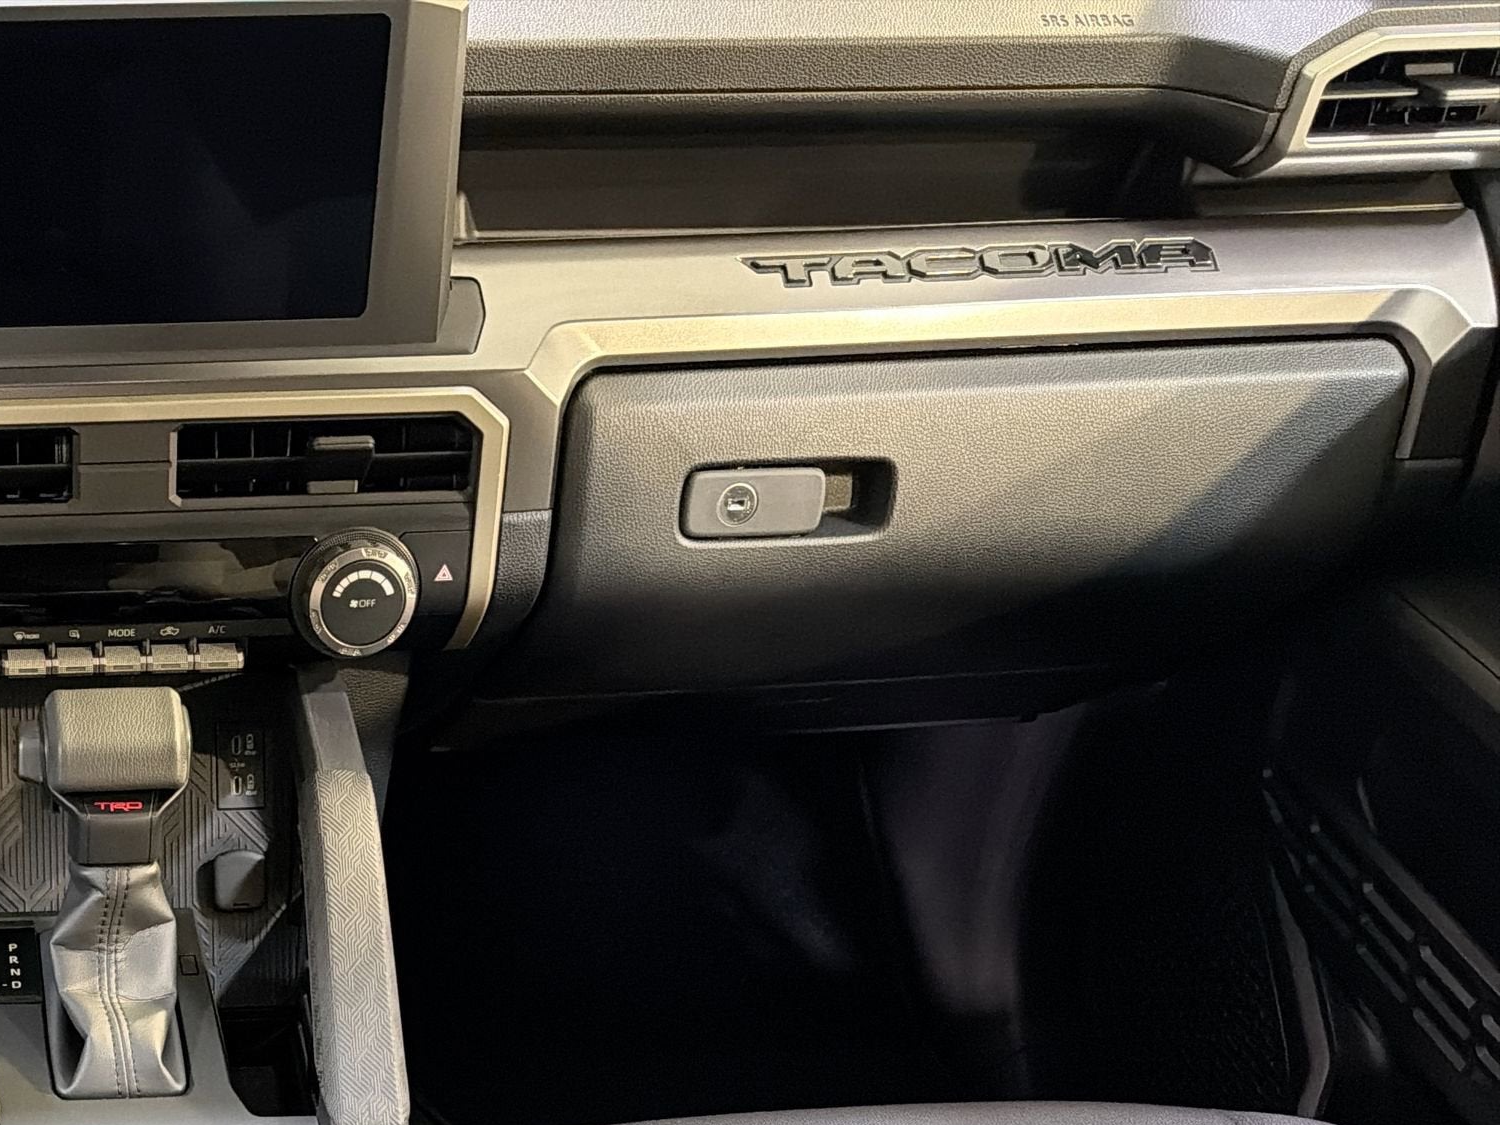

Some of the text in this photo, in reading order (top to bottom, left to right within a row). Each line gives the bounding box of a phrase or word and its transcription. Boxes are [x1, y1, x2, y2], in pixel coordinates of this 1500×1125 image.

[1040, 14, 1134, 27] SRS AIRBAG
[736, 237, 1220, 287] TACOMA
[358, 599, 377, 608] OFF
[107, 628, 136, 638] MODE
[208, 625, 227, 635] A/C
[93, 801, 143, 812] TRD
[8, 943, 18, 952] P
[8, 955, 19, 964] R
[9, 968, 21, 976] N
[11, 980, 22, 989] D
